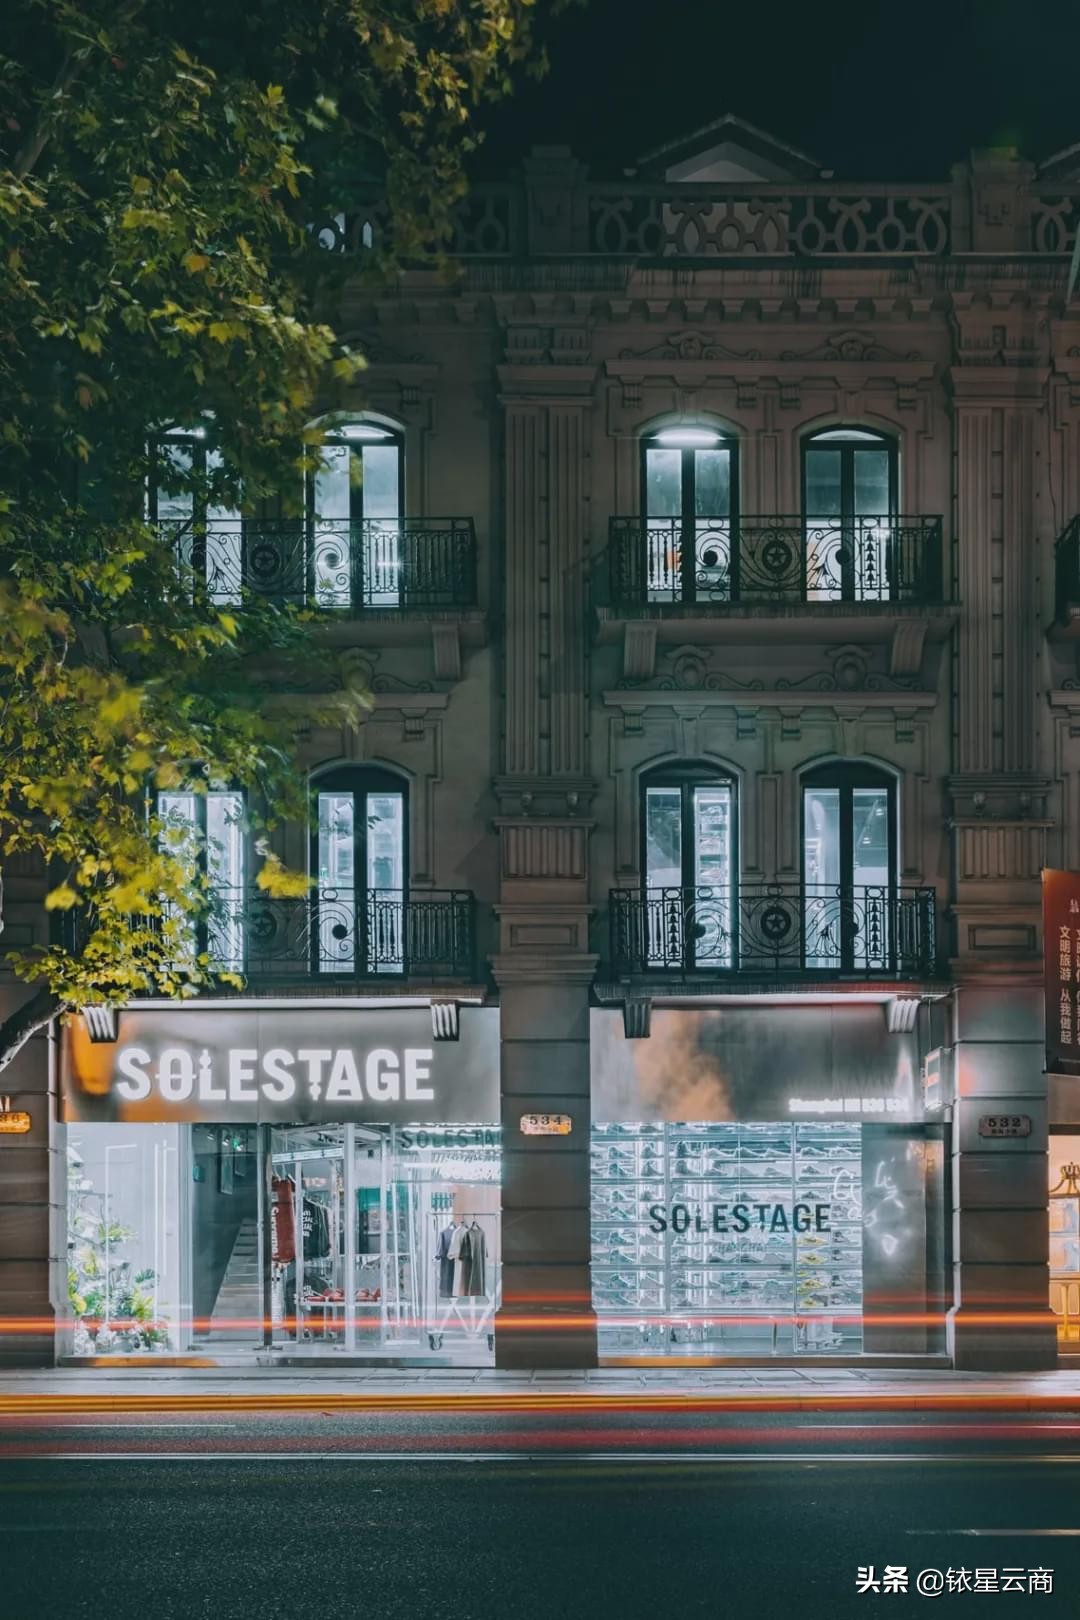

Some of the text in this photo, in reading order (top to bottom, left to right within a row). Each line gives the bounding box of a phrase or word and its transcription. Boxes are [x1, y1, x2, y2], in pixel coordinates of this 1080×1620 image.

[116, 1048, 435, 1101] SOLESTAGE
[530, 1116, 561, 1125] 534
[988, 1117, 1021, 1128] 532
[649, 1203, 832, 1234] SOLESTAGE
